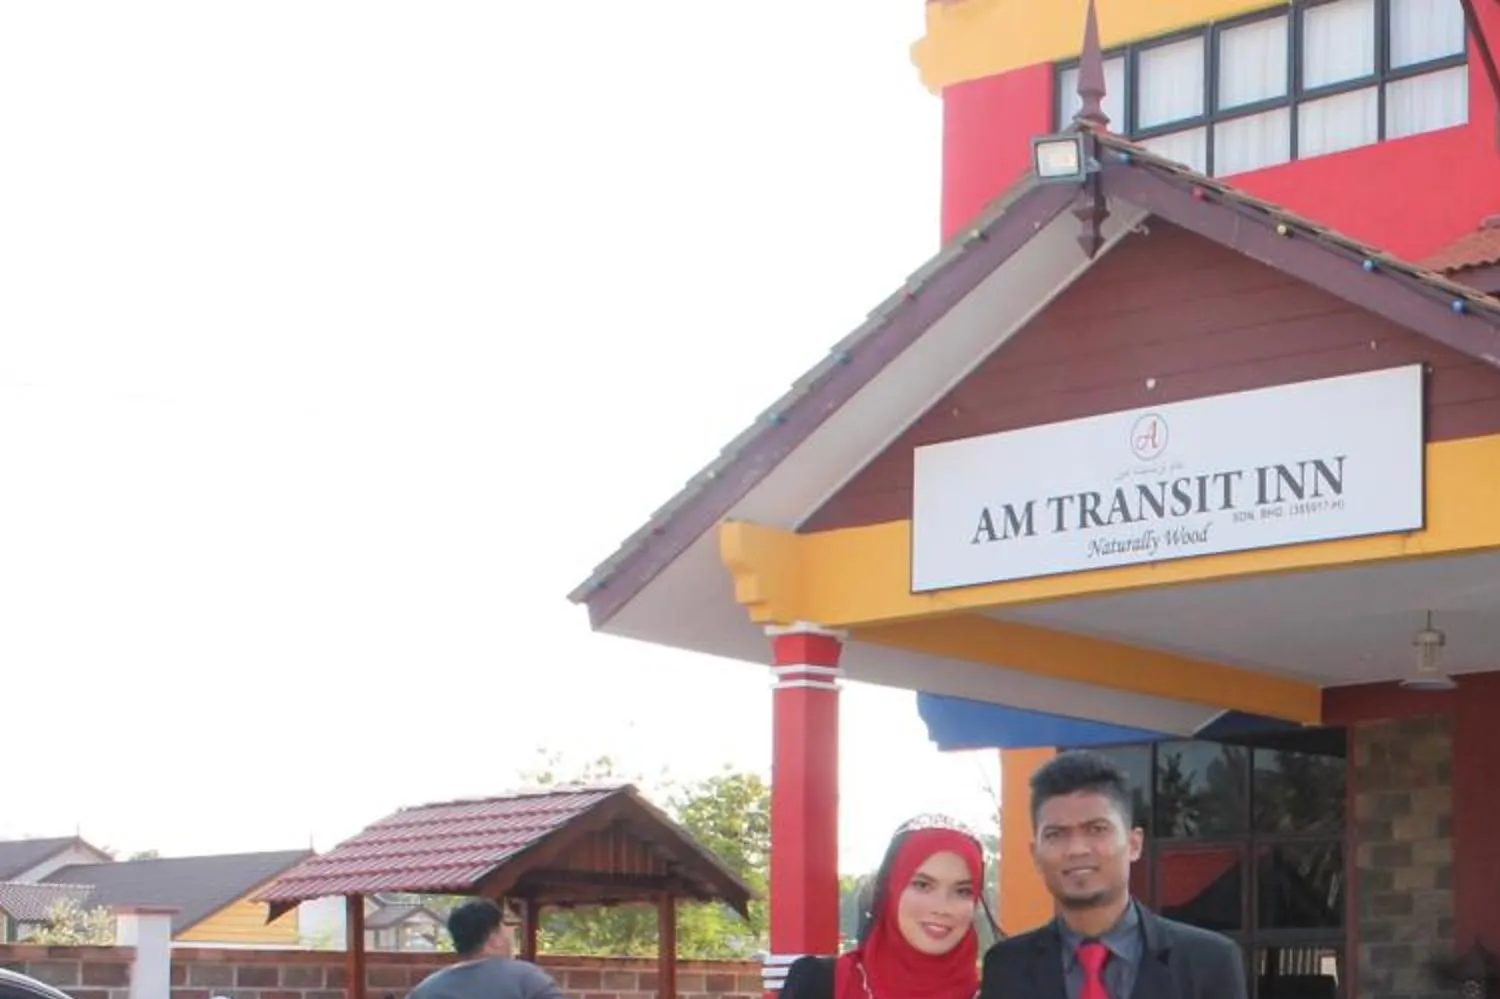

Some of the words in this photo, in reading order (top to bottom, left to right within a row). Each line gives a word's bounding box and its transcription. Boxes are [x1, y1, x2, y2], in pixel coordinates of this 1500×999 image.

[970, 499, 1038, 544] AM
[1047, 470, 1242, 533] TRANSIT
[1255, 455, 1347, 505] INN
[1087, 529, 1160, 558] Naturally
[1165, 521, 1213, 546] Wood
